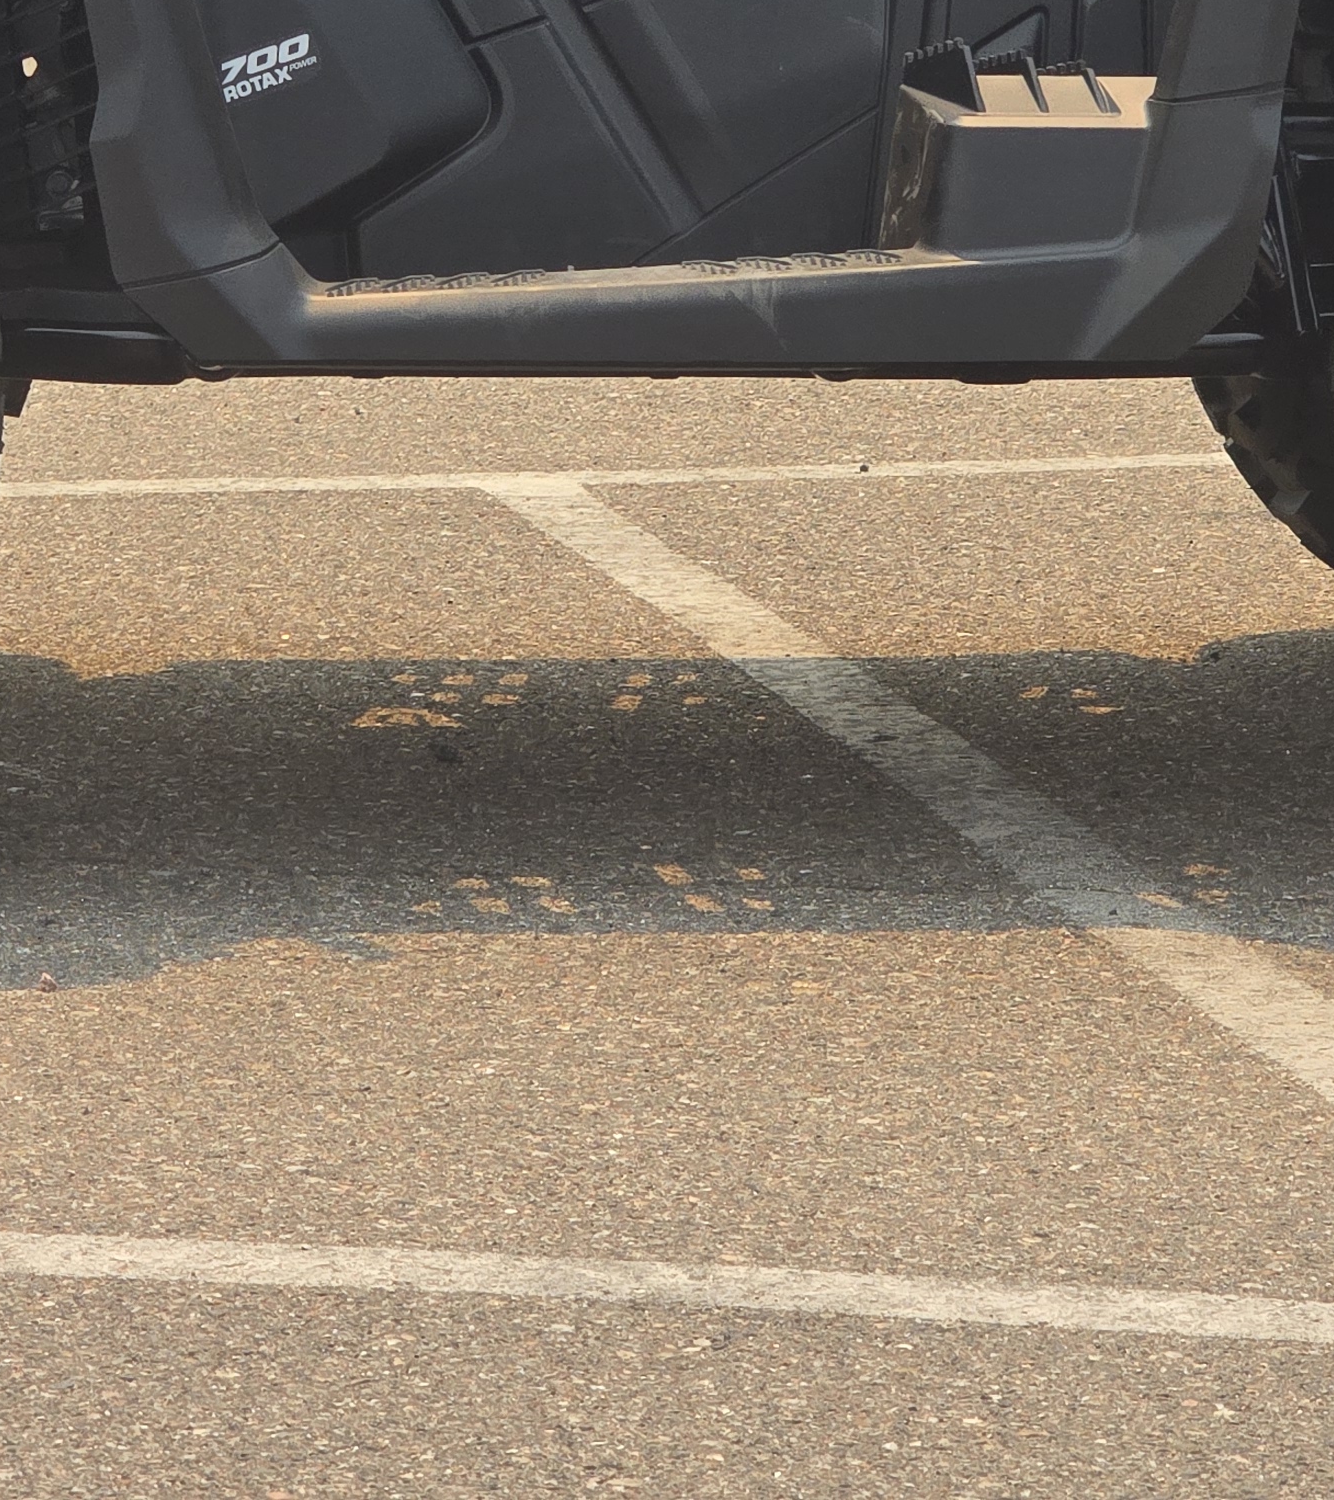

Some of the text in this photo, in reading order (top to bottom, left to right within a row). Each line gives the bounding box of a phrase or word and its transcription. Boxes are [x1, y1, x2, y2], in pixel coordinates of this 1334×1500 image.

[221, 33, 310, 85] 700
[222, 55, 317, 103] ROTAX POWER
